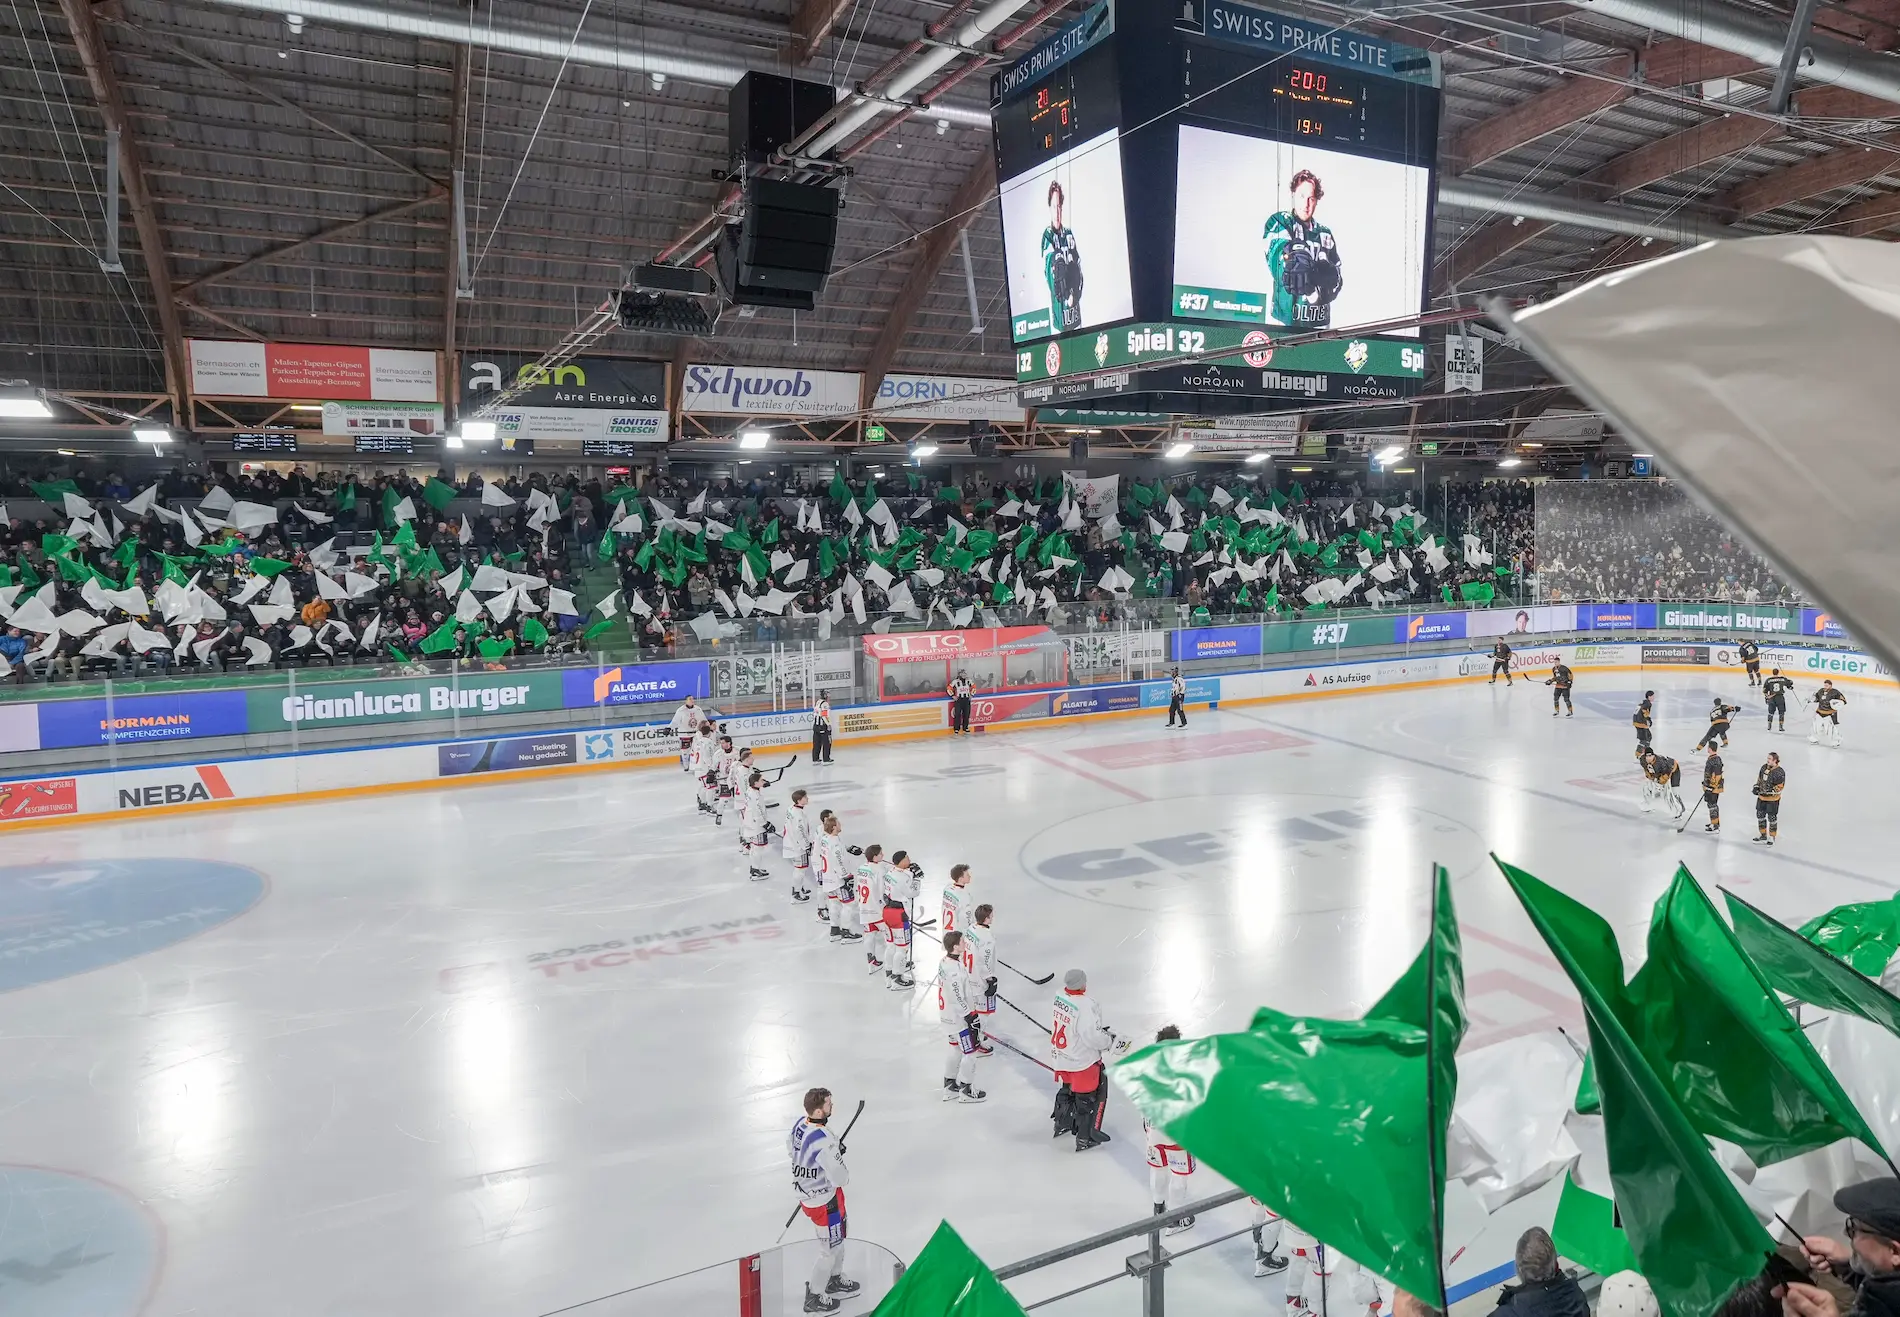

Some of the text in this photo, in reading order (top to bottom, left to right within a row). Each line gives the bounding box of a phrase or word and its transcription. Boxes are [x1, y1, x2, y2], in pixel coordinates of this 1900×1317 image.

[1212, 8, 1388, 68] SWISS PRIME SITE
[1003, 23, 1085, 93] SWISS PRIME SITE
[1179, 293, 1209, 311] #37
[1127, 328, 1205, 356] Spiel 32
[303, 360, 333, 368] Tapeten
[336, 361, 362, 369] Gipsen
[1020, 352, 1032, 372] 32
[272, 367, 366, 378] Parkett Teppiche Platten
[277, 377, 361, 387] Ausstellung Beratung
[686, 366, 812, 408] Schwob
[1183, 376, 1244, 388] NORQAIN
[880, 380, 946, 399] BORN
[1059, 383, 1087, 396] NORQAIN
[1344, 385, 1397, 397] NORQAIN
[555, 391, 657, 404] Aare Energie AG
[746, 399, 857, 412] textiles of Switzerland
[944, 404, 955, 414] to
[958, 406, 987, 415] travel
[612, 417, 659, 427] SANITAS
[609, 425, 657, 434] TROESCH
[1638, 461, 1645, 471] B
[1665, 610, 1789, 633] Gianluca Burger
[1312, 624, 1349, 645] #37
[1418, 624, 1451, 634] ALGATE AG
[873, 633, 965, 654] OTTO
[923, 654, 954, 662] TREUHAND
[955, 652, 975, 660] IMMER
[982, 649, 1017, 658] POWERPLAY
[1576, 647, 1595, 660] AfA
[1643, 648, 1687, 658] prometall
[1508, 651, 1561, 670] Quooker
[1807, 651, 1868, 673] dreier
[1322, 672, 1371, 685] AS Aufzüge
[612, 680, 677, 693] ALGATE AG
[1773, 682, 1780, 693] 8
[282, 685, 530, 722] Gianluca Burger
[612, 694, 629, 702] TORE
[1062, 699, 1098, 710] ALGATE AG
[735, 713, 814, 730] SCHERRER AG
[844, 719, 872, 727] ELEKTRO
[101, 727, 191, 740] KOMPETENZCENTER
[844, 724, 880, 733] TELEMATIK
[531, 743, 568, 752] Ticketing.
[750, 735, 802, 747] BODENBELÄGE
[535, 751, 568, 761] gedacht.
[118, 782, 210, 809] NEBA
[710, 913, 777, 931] WM
[531, 925, 786, 978] TICKETS
